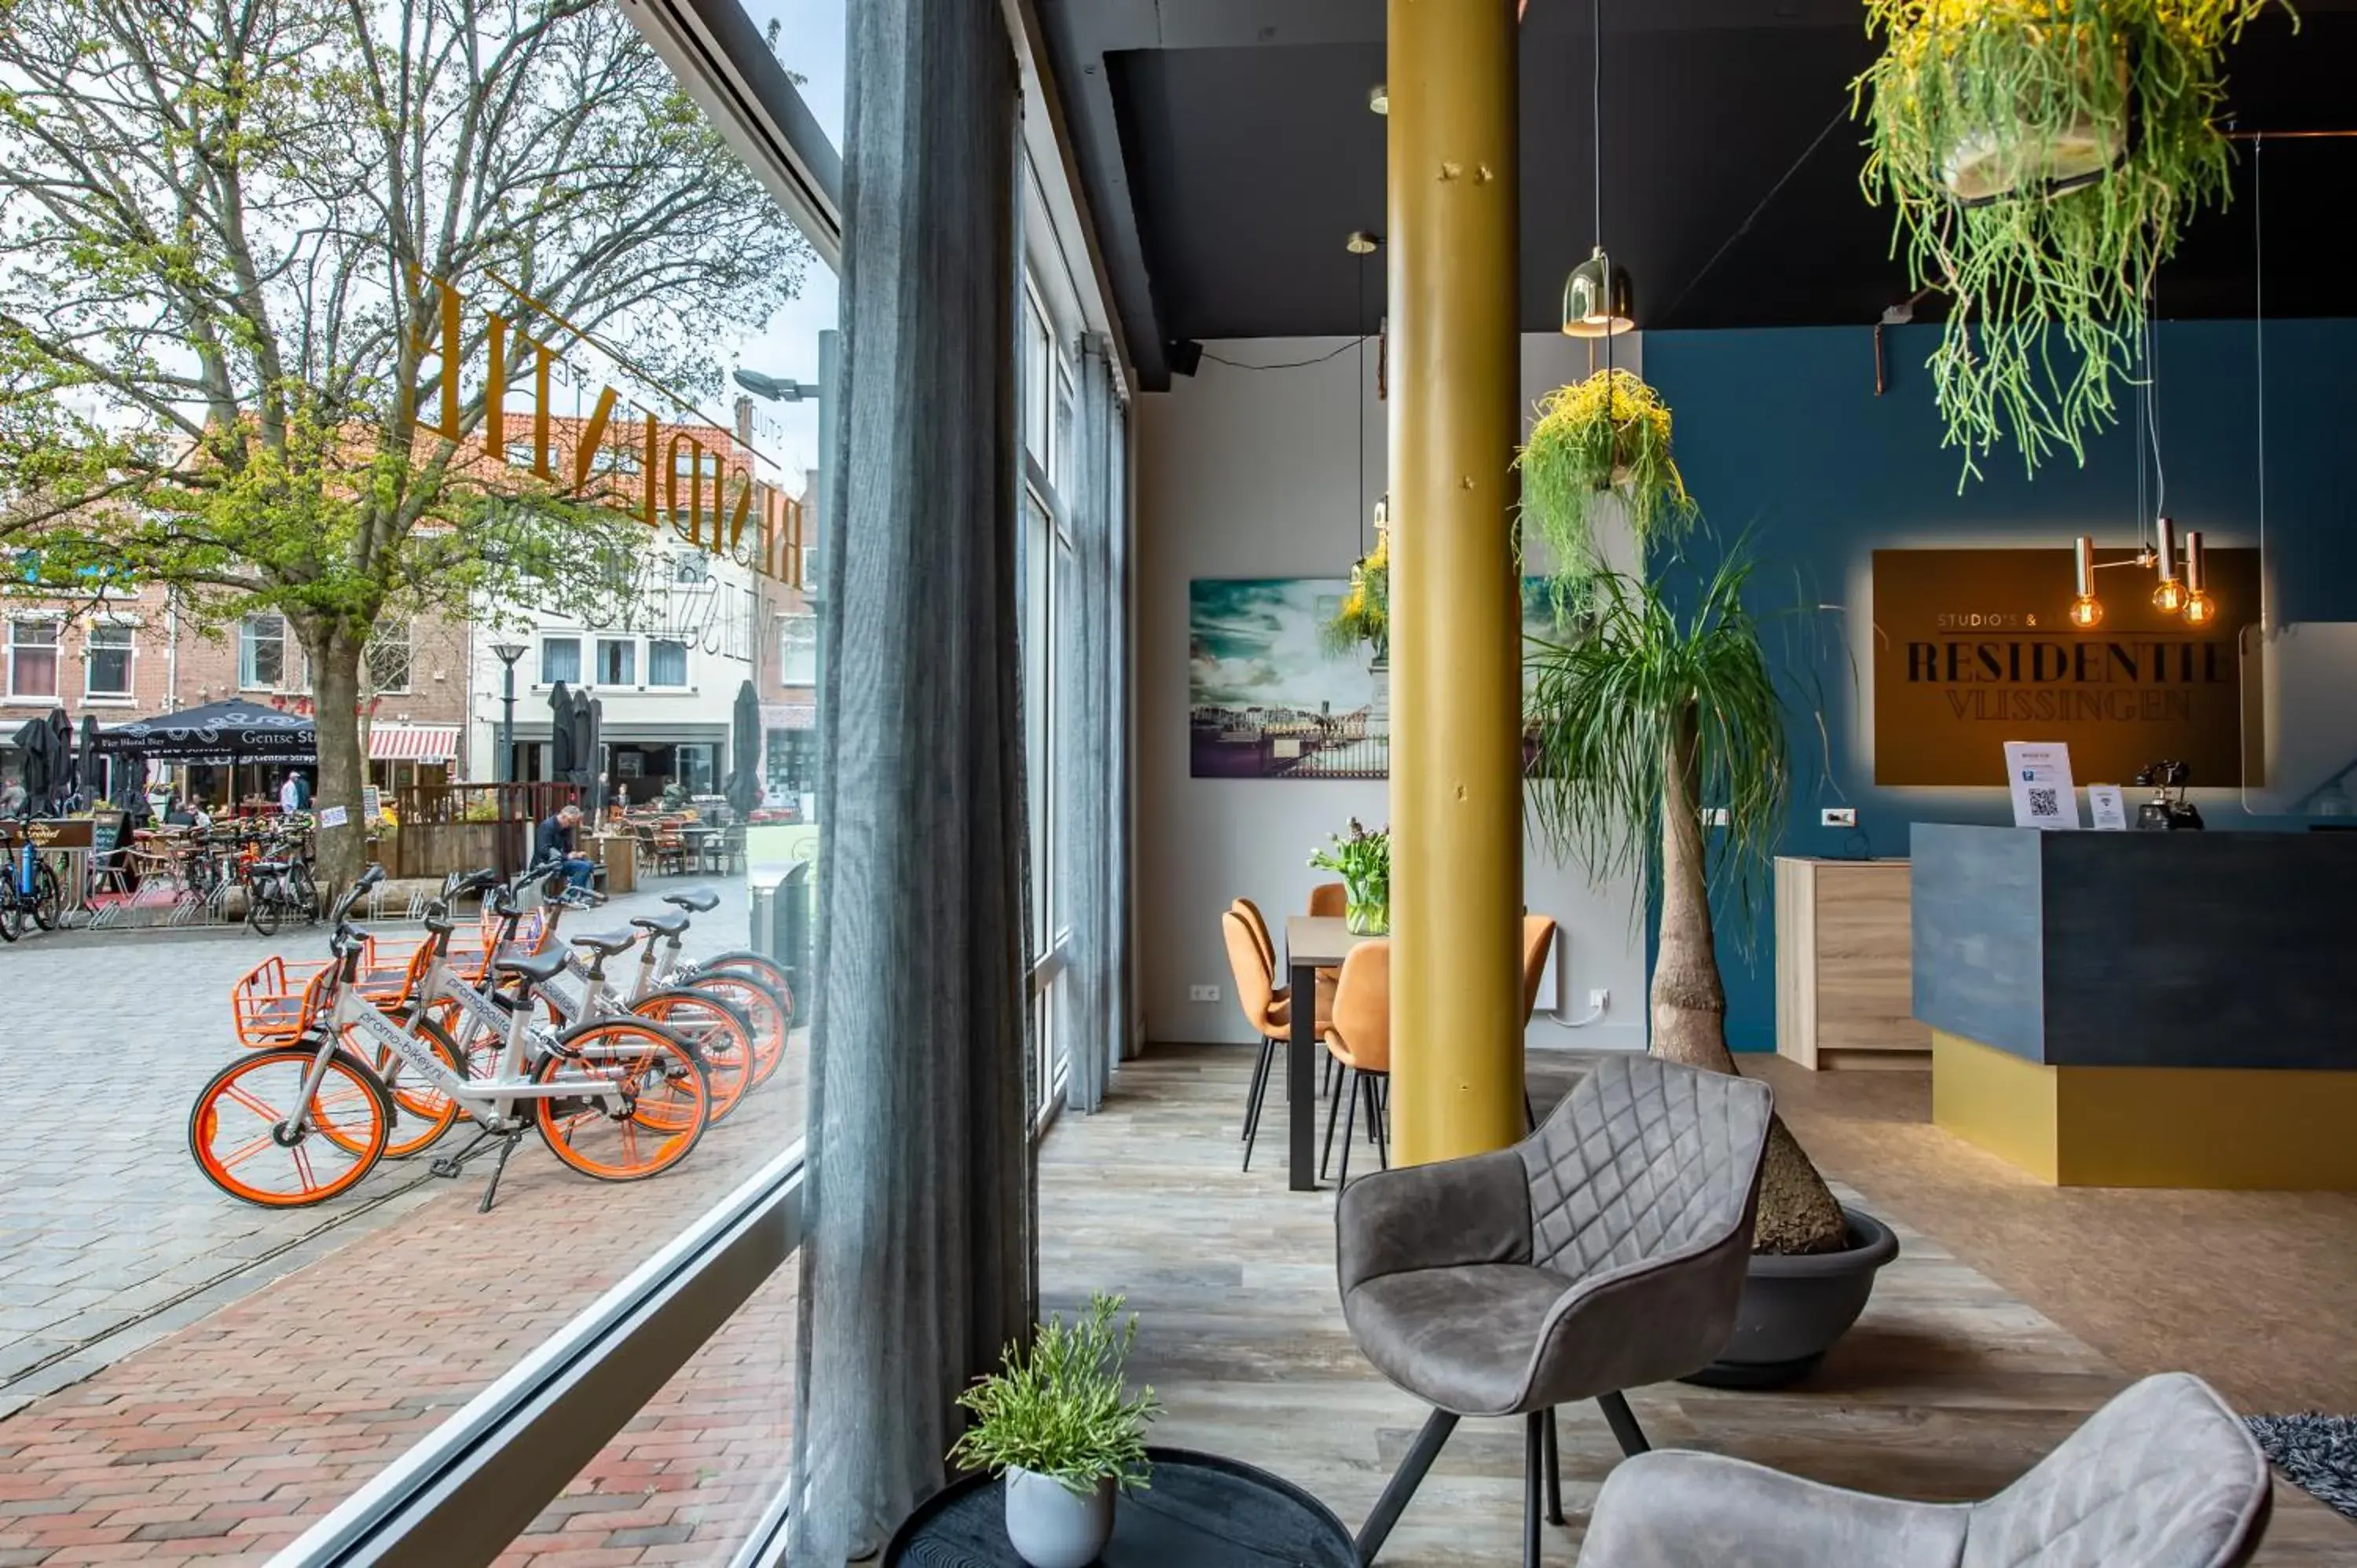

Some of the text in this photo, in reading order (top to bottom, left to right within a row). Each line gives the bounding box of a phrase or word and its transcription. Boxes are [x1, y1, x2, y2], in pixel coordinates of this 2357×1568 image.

[1938, 613, 2017, 627] STUDIO'S
[2026, 613, 2037, 627] &
[1907, 641, 2229, 683] RESIDENTIE
[1945, 688, 2194, 722] VLISSINGEN
[241, 730, 294, 744] Gentse
